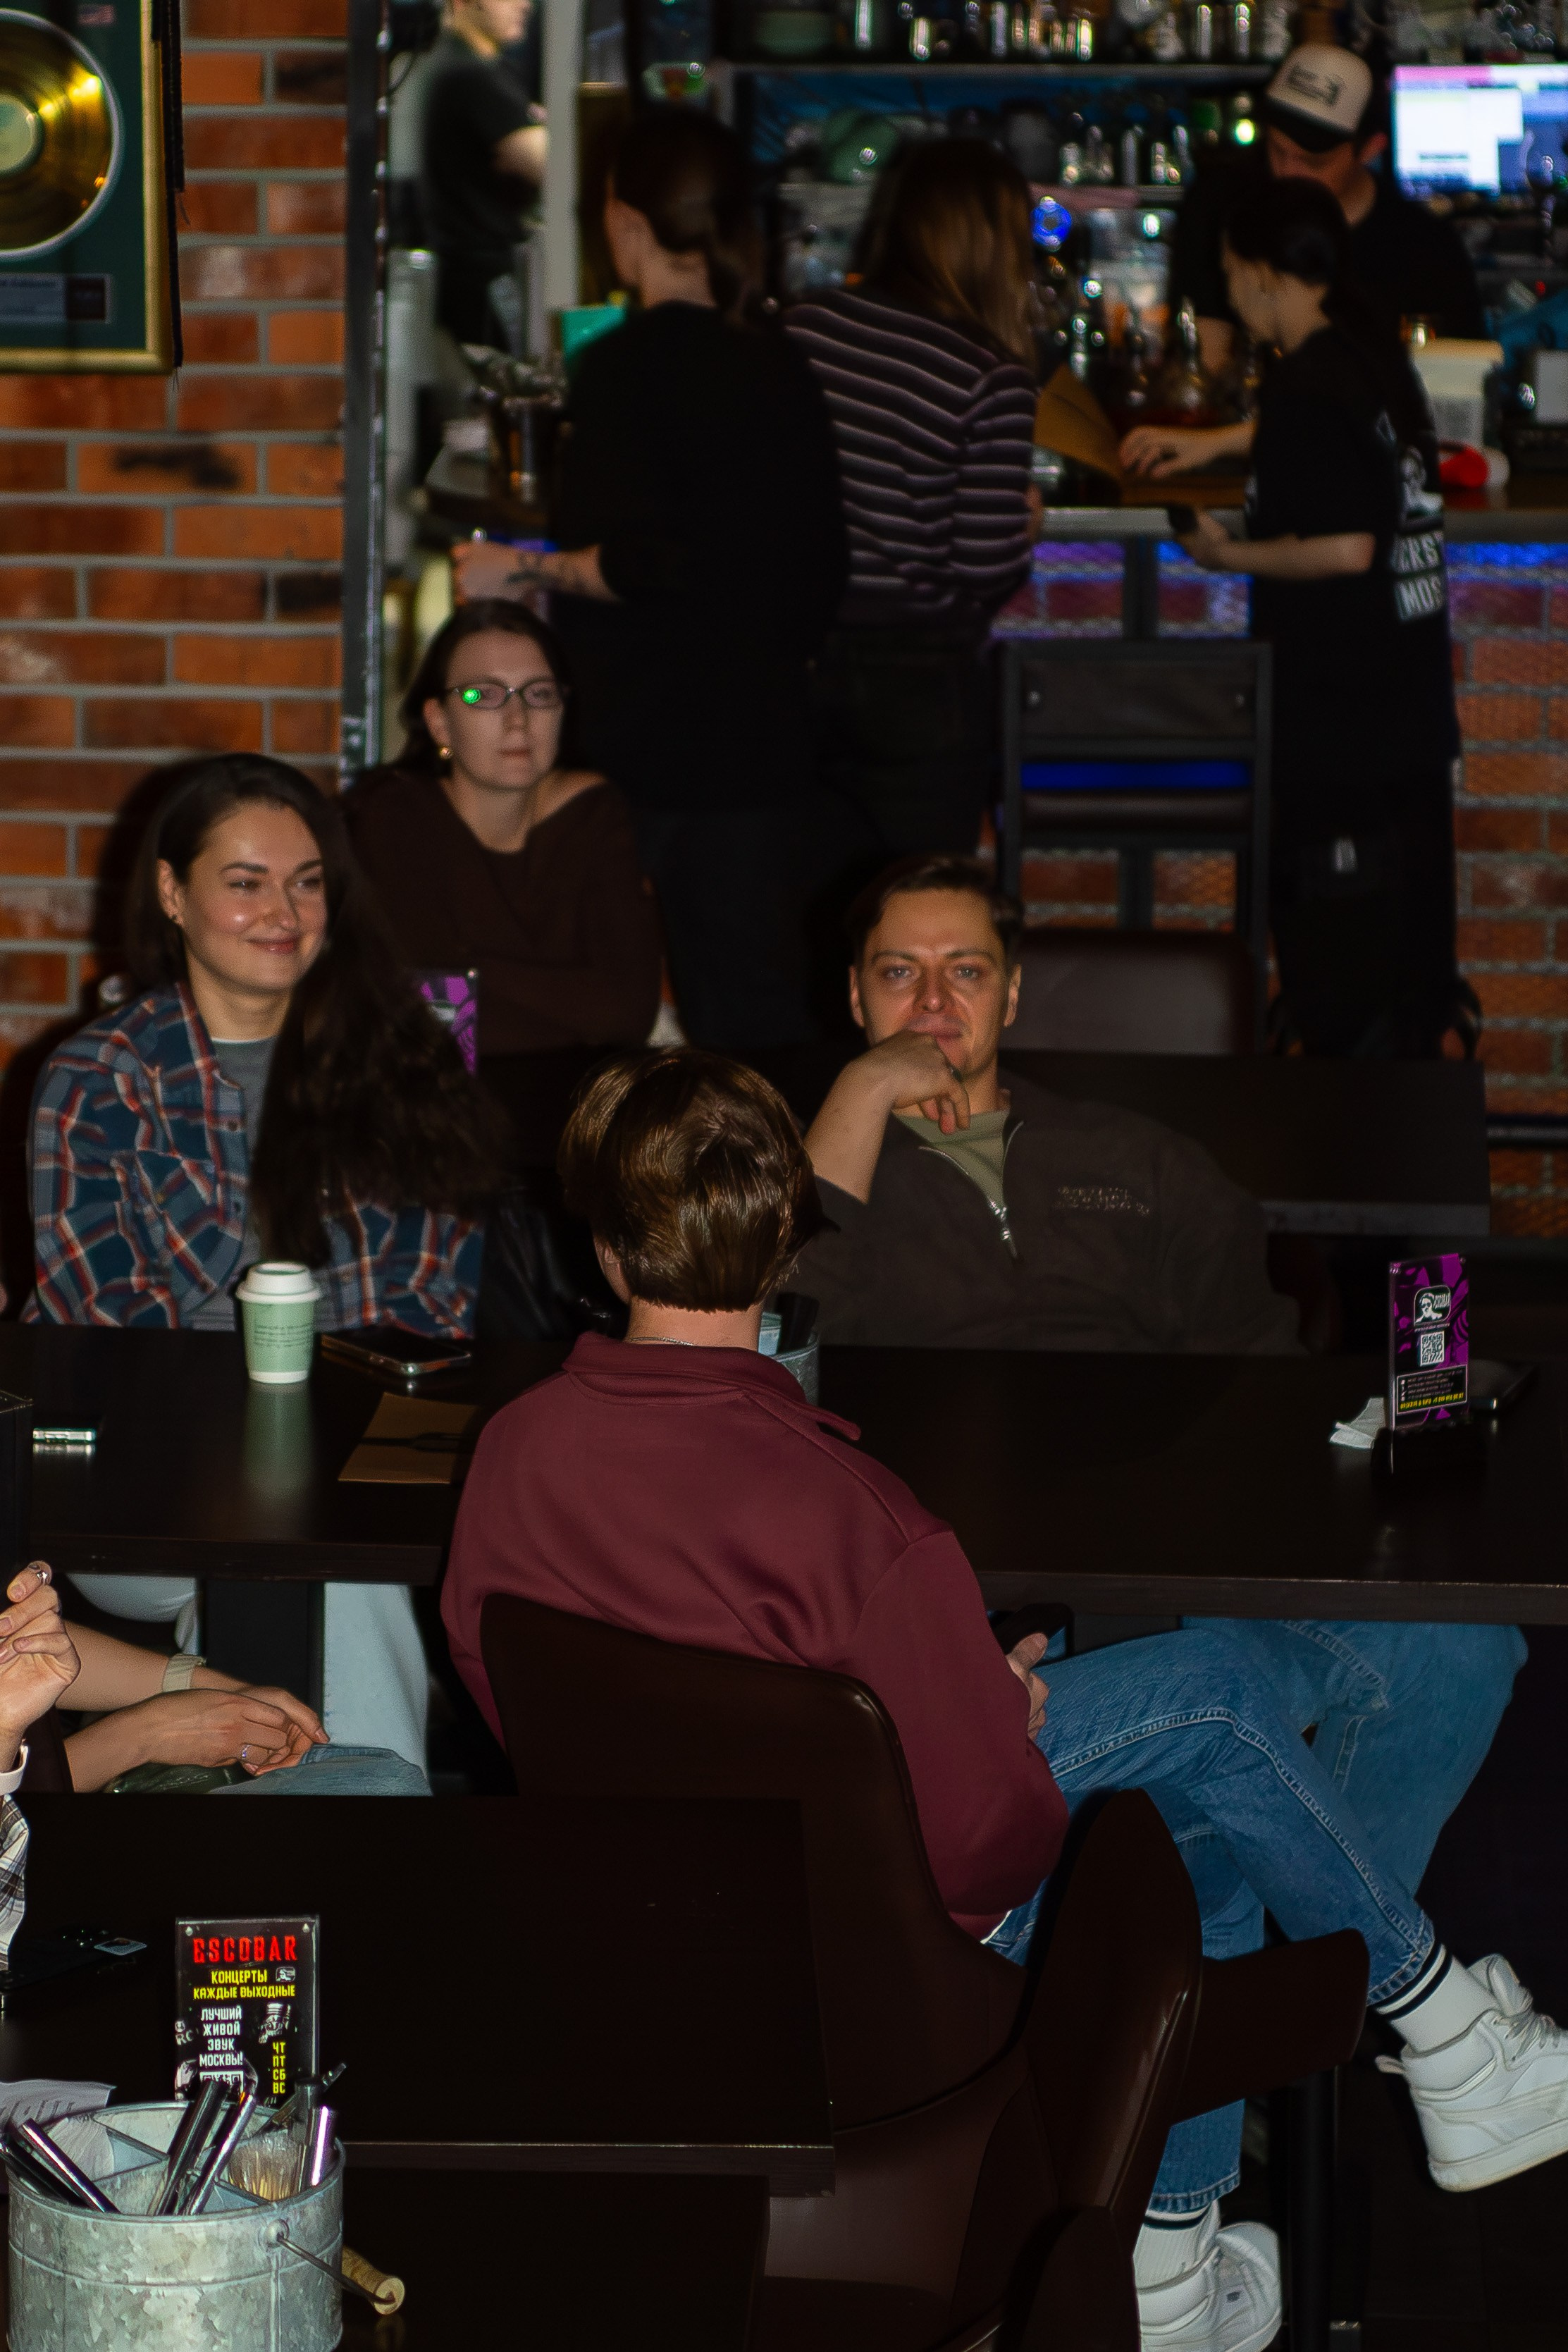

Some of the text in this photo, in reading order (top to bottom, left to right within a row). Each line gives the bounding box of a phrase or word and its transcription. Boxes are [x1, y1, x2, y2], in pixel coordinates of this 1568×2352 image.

[193, 1935, 297, 1963] ESCOBAR
[211, 1969, 268, 1985] КОНЦЕРТЫ
[193, 1985, 295, 2000] КАЖДЫЕ ВЫХОДНЫЕ
[200, 2005, 242, 2021] ЛУЧШИЙ
[203, 2021, 240, 2036] ЖИВОЙ
[207, 2038, 235, 2051] ЗВУК
[272, 2041, 286, 2054] ЧТ
[199, 2052, 243, 2067] МОСКВЫ!
[272, 2055, 286, 2067] ПТ
[272, 2069, 286, 2080] СБ
[272, 2082, 286, 2094] ВС
